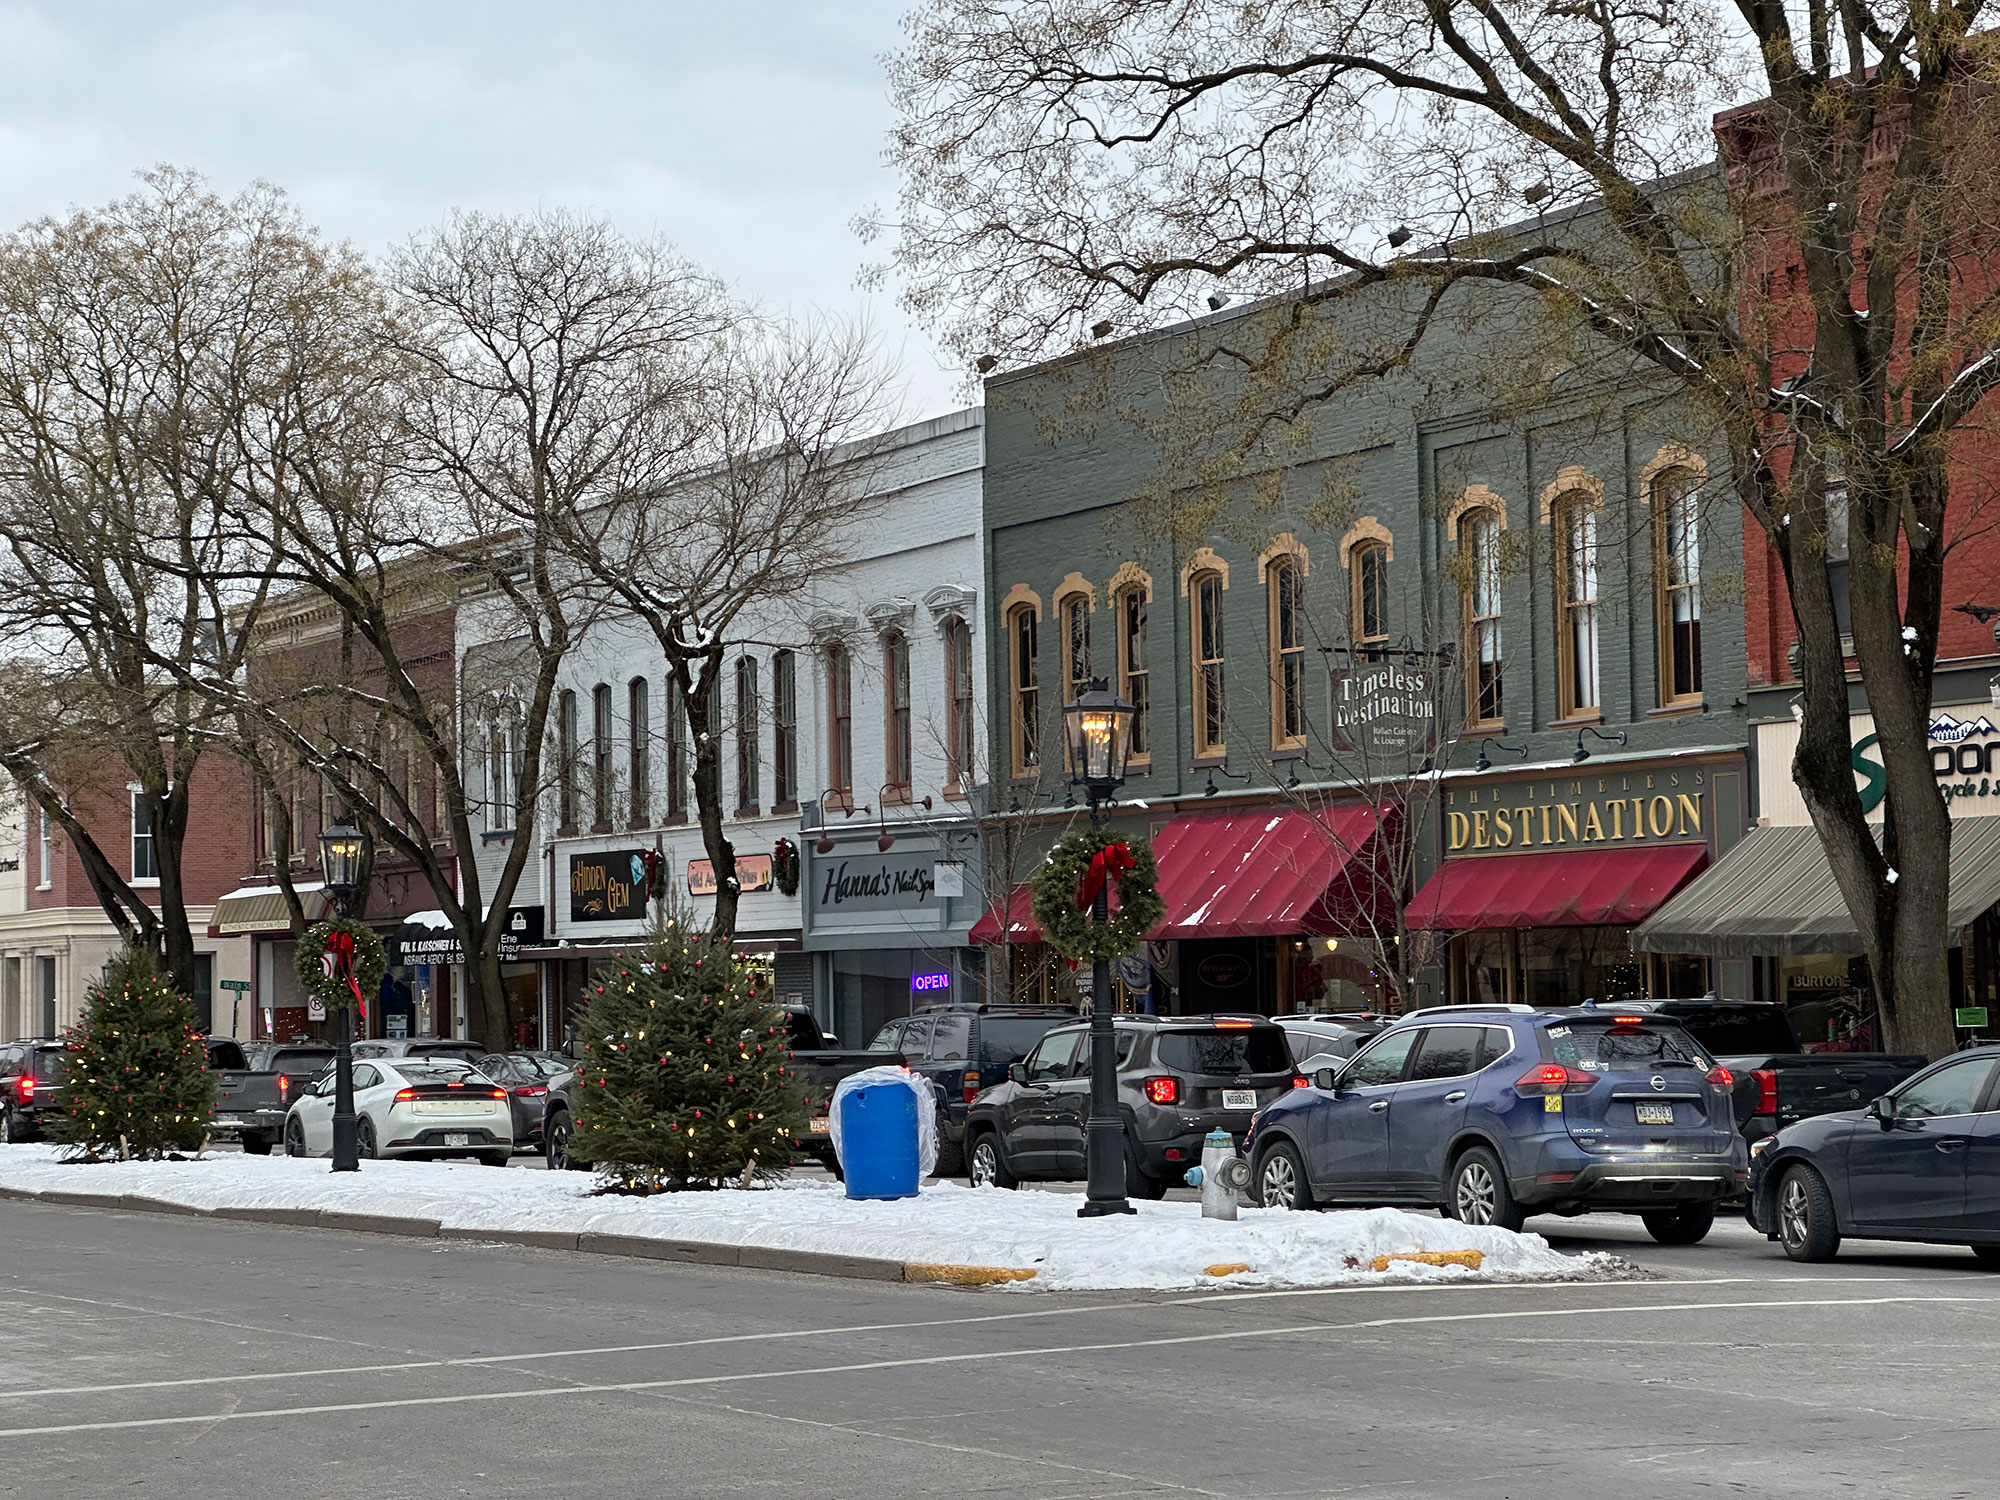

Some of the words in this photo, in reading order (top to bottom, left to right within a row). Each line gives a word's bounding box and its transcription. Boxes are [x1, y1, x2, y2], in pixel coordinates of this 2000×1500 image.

[1340, 665, 1424, 700] Timeless
[1336, 693, 1434, 727] Destination
[1373, 737, 1380, 745] &
[1381, 737, 1406, 746] Lounge
[1447, 789, 1500, 805] THE
[1526, 770, 1704, 800] TIMELESS
[1447, 792, 1703, 850] DESTINATION
[821, 861, 891, 905] Hanna's
[892, 868, 919, 895] Nail
[250, 921, 273, 929] MEXICAN
[274, 920, 288, 928] FOOD
[501, 934, 518, 943] Erie
[915, 974, 949, 990] OPEN
[1580, 1060, 1597, 1068] OBX
[1233, 1077, 1250, 1085] Jeep
